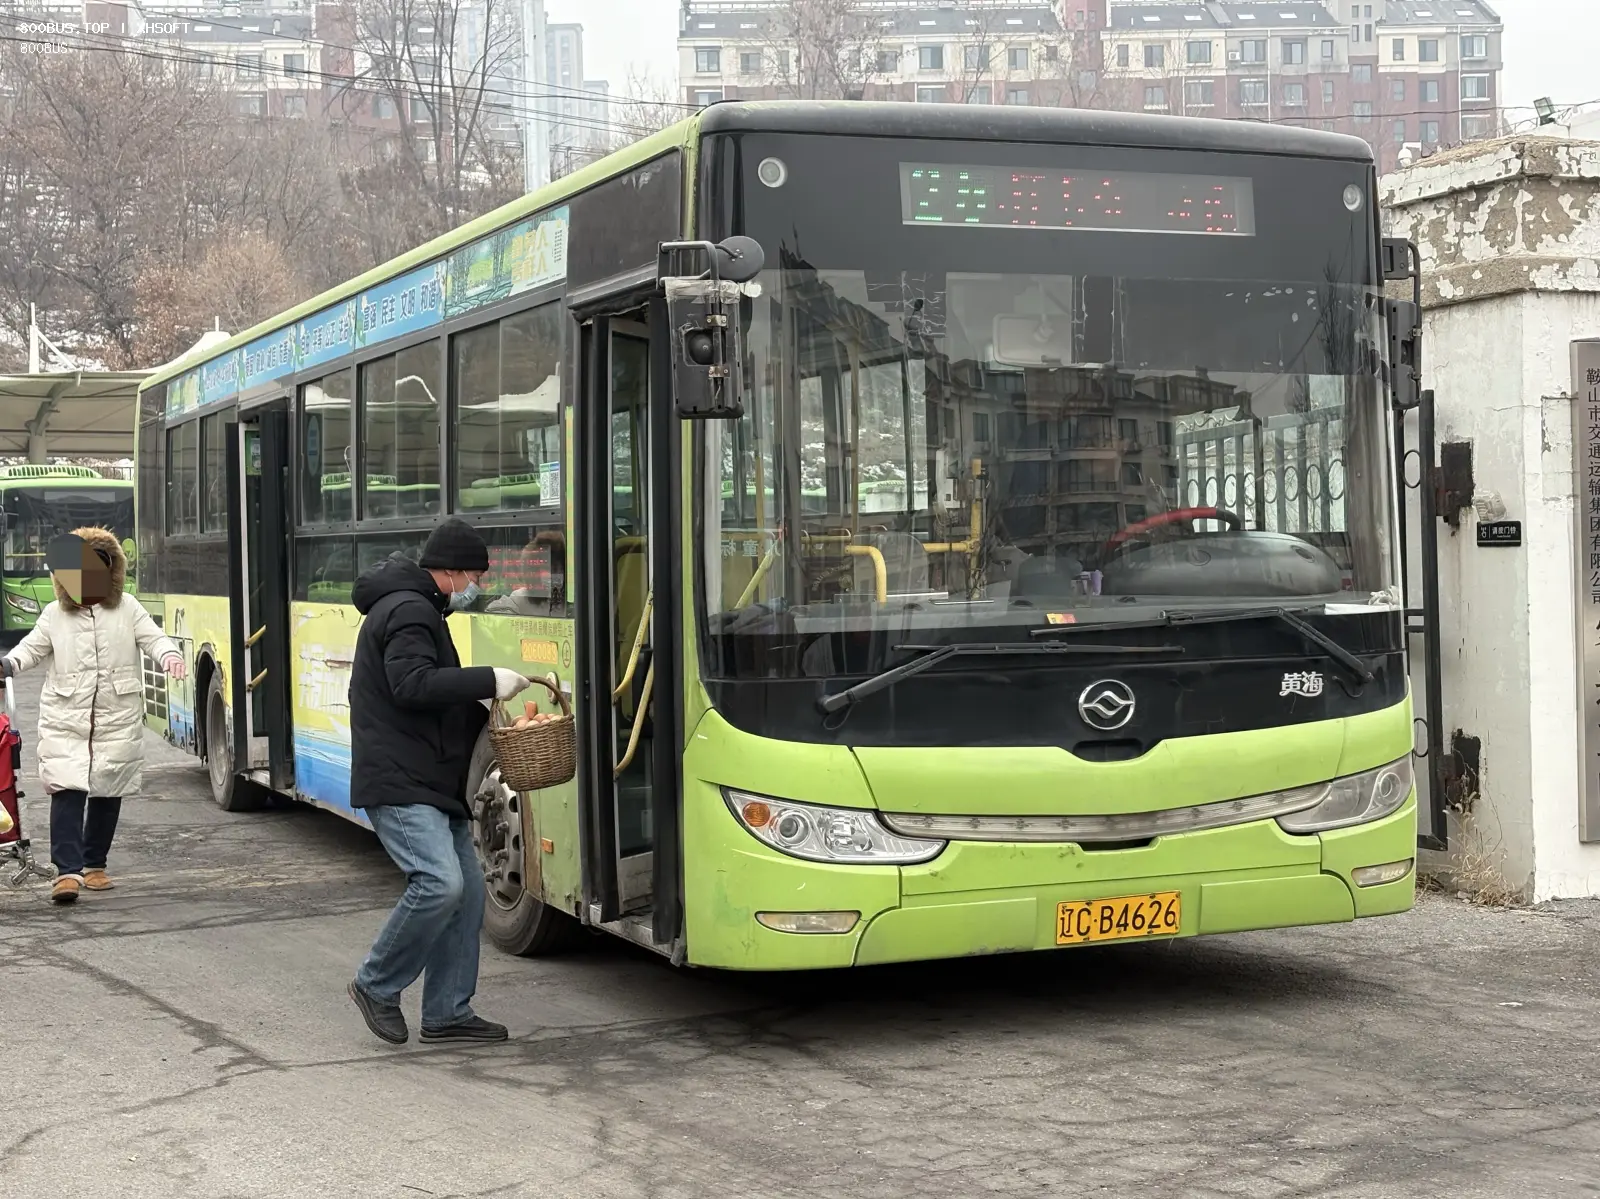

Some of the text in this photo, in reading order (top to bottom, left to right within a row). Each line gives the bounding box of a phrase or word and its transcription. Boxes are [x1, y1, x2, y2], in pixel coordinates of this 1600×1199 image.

[362, 280, 437, 333] 富强 民主 文明 和谐
[1279, 671, 1324, 697] 黄海
[1059, 898, 1177, 938] 辽C·B4626
